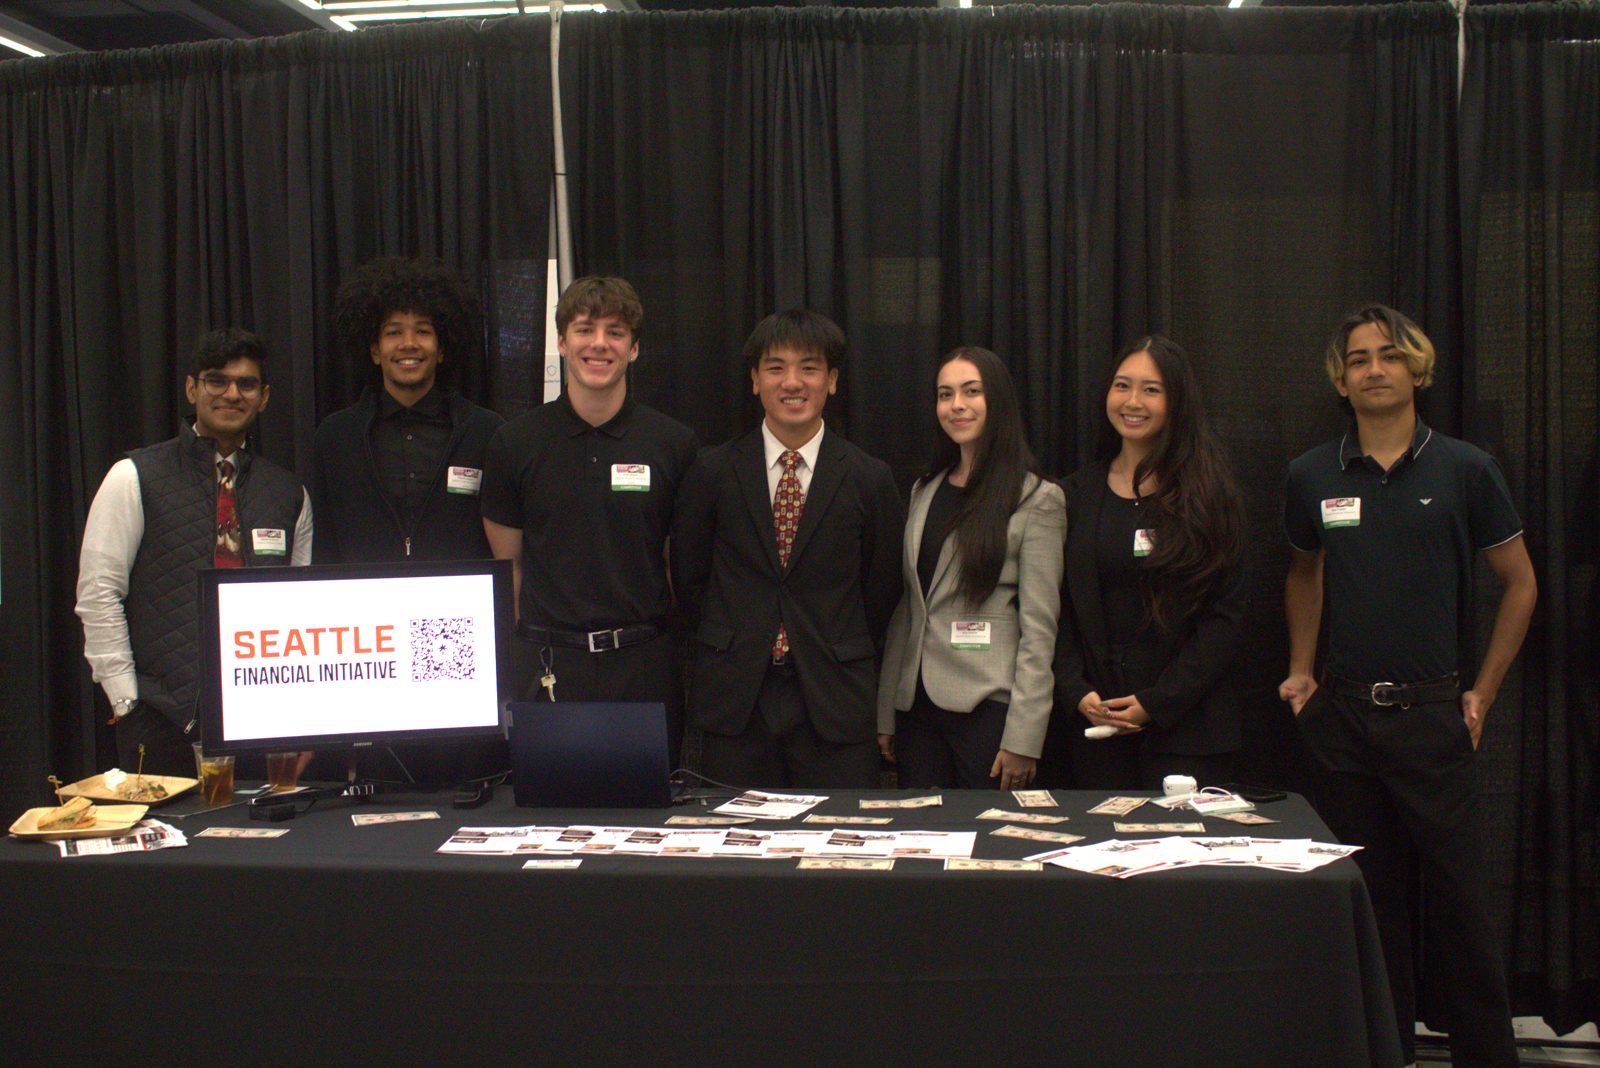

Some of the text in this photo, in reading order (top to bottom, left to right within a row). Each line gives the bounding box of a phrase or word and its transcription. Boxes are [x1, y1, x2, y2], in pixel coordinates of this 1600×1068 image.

[234, 625, 395, 659] SEATTLE
[234, 661, 397, 686] FINANCIAL INITIATIVE
